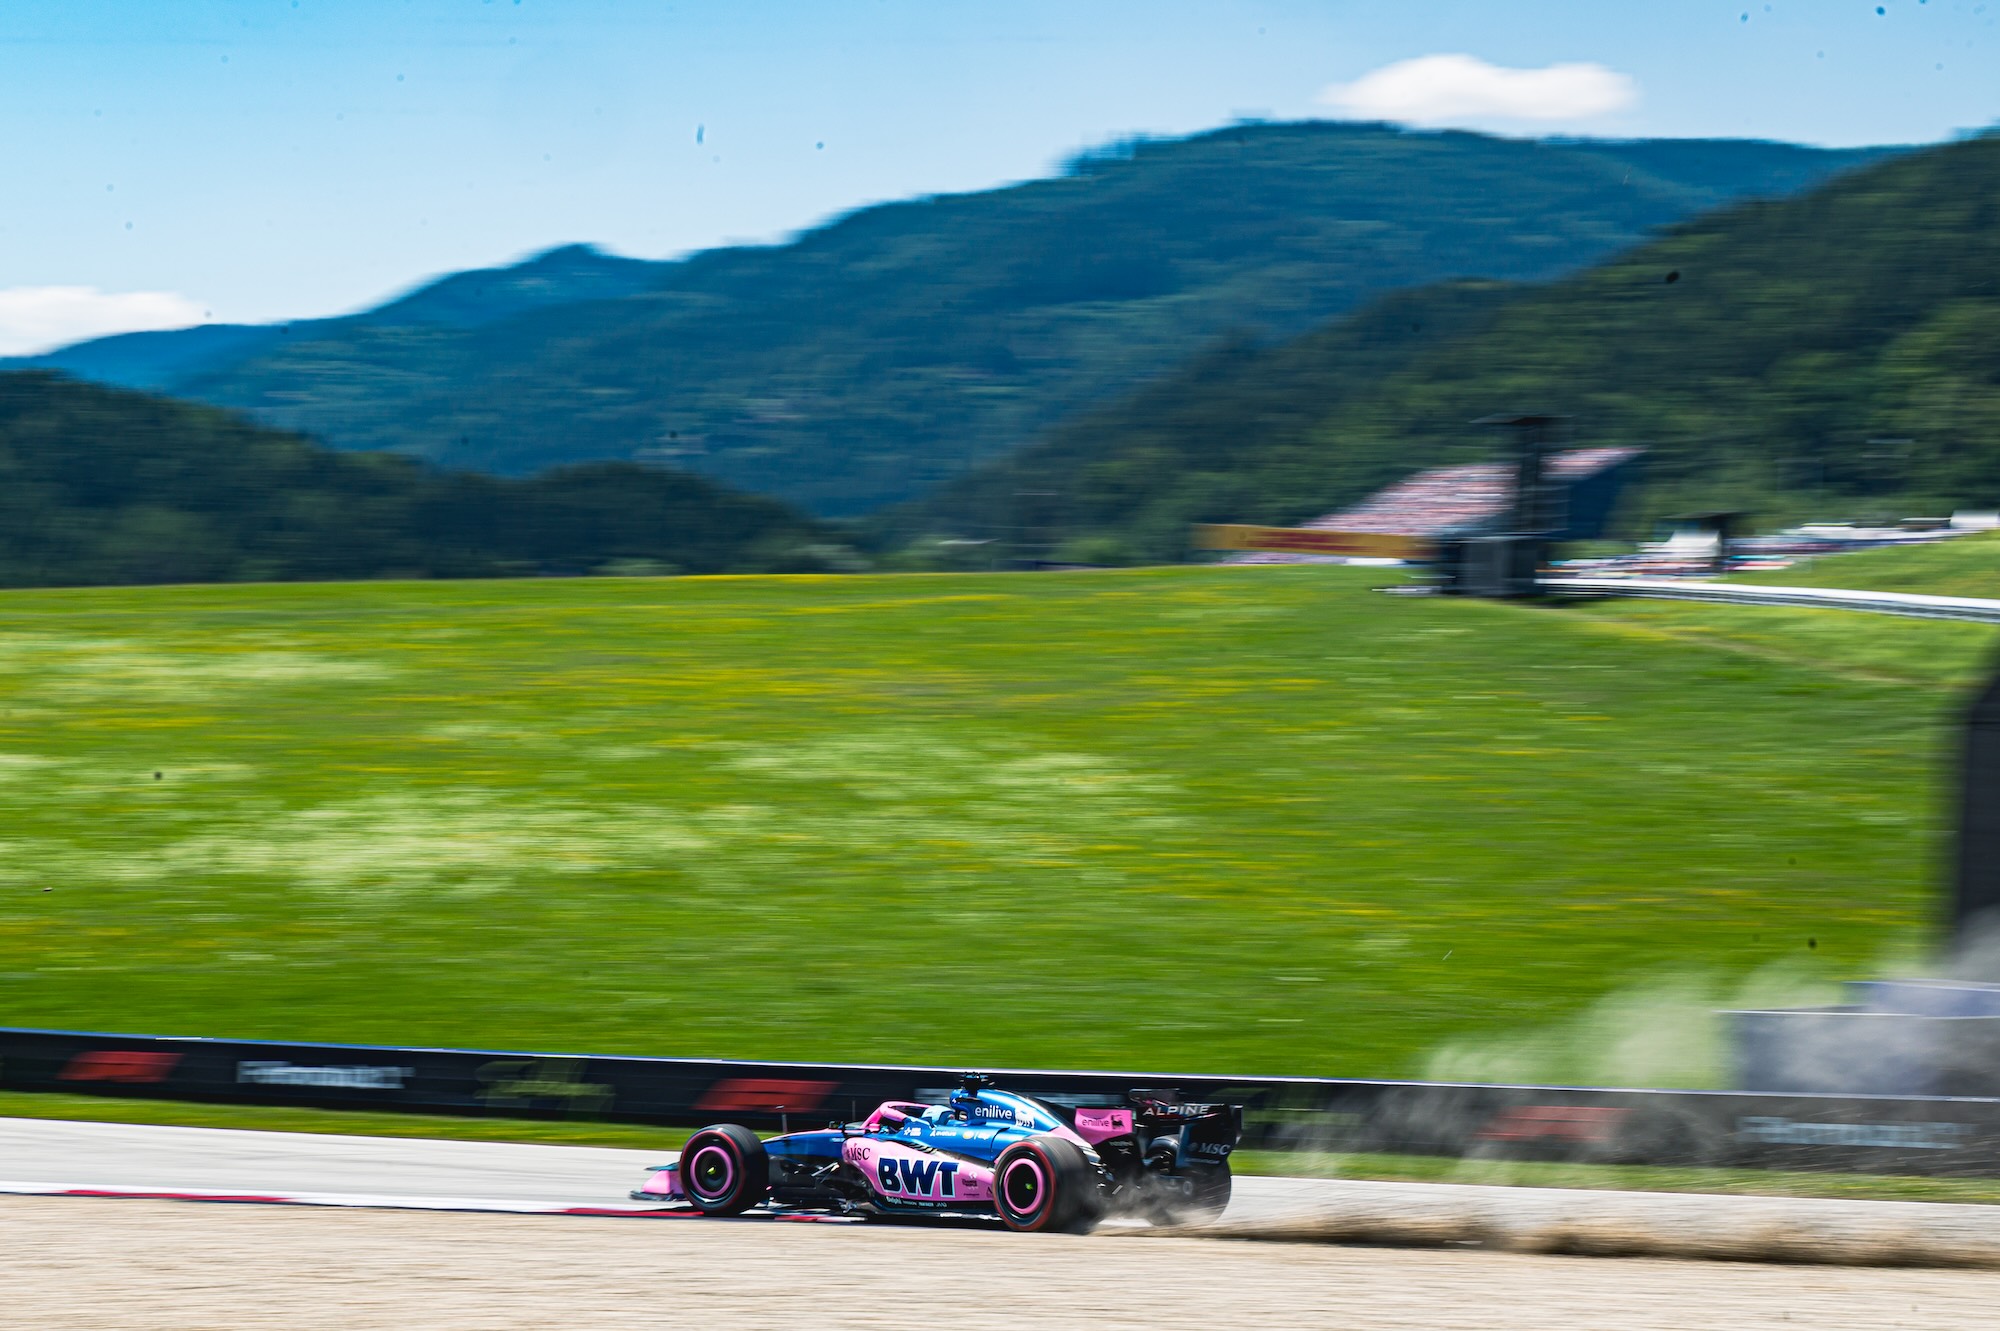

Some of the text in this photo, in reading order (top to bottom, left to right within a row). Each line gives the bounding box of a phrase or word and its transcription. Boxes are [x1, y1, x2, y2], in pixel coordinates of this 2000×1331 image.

[975, 1105, 1012, 1119] enilive
[1143, 1105, 1210, 1116] ALPINE
[1082, 1118, 1110, 1127] enilive
[850, 1146, 870, 1160] MSC
[1199, 1143, 1231, 1155] MSC
[877, 1155, 959, 1198] BWT
